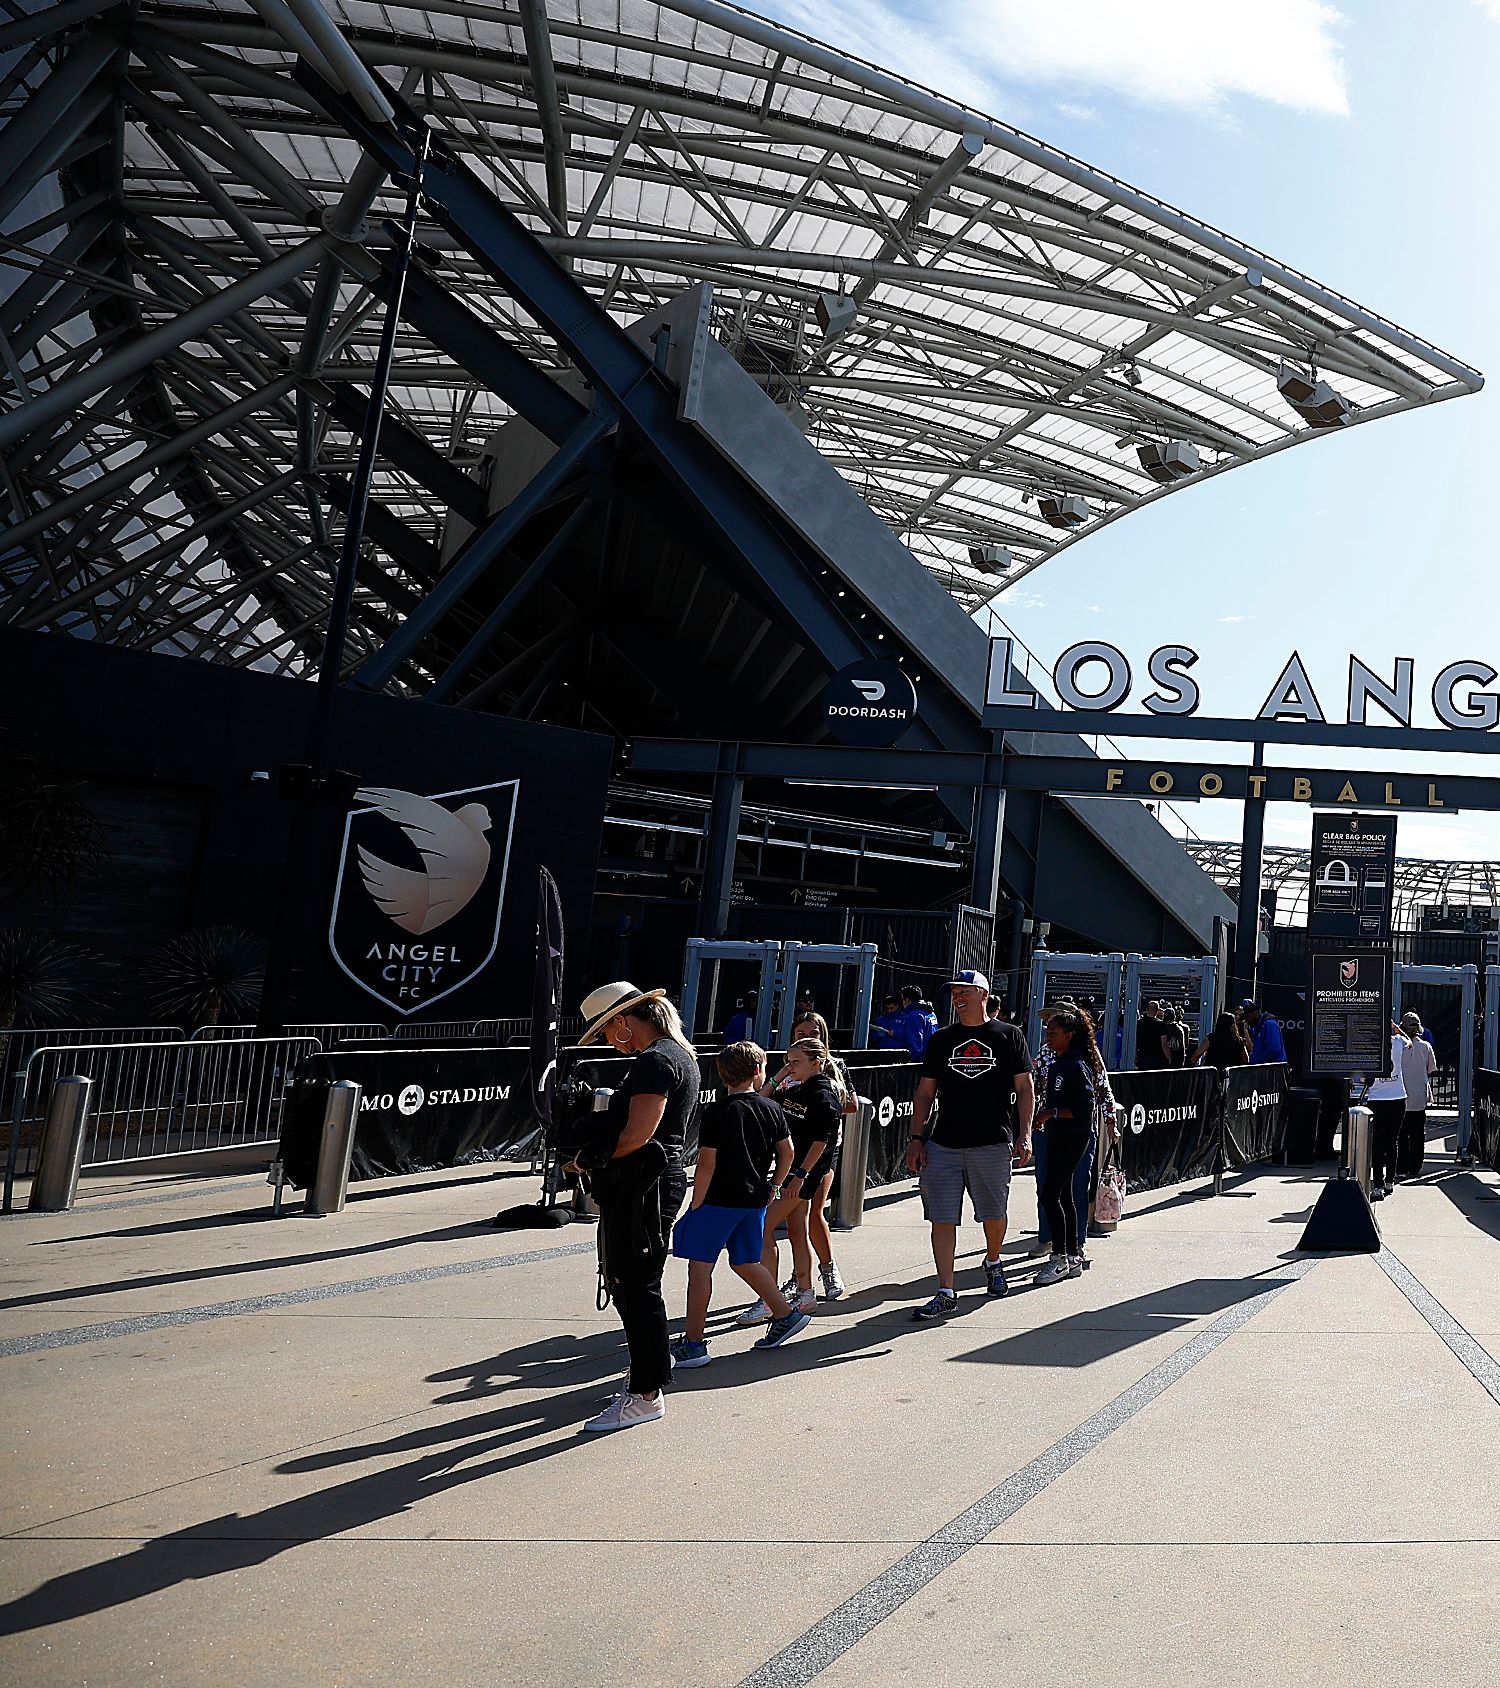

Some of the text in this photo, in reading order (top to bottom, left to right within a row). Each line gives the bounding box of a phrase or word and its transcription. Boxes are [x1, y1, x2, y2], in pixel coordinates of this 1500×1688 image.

[984, 636, 1200, 717] LOS
[829, 705, 906, 719] DOORDASH
[1106, 768, 1444, 806] FOOTBALL
[1322, 832, 1344, 840] CLEAR
[1345, 833, 1360, 841] BAG
[366, 942, 461, 962] ANGEL
[382, 964, 443, 983] CITY
[399, 986, 420, 998] FC
[1359, 990, 1380, 998] ITEMS
[359, 1086, 511, 1112] MO STADIUM
[1147, 1105, 1198, 1126] STADIUM
